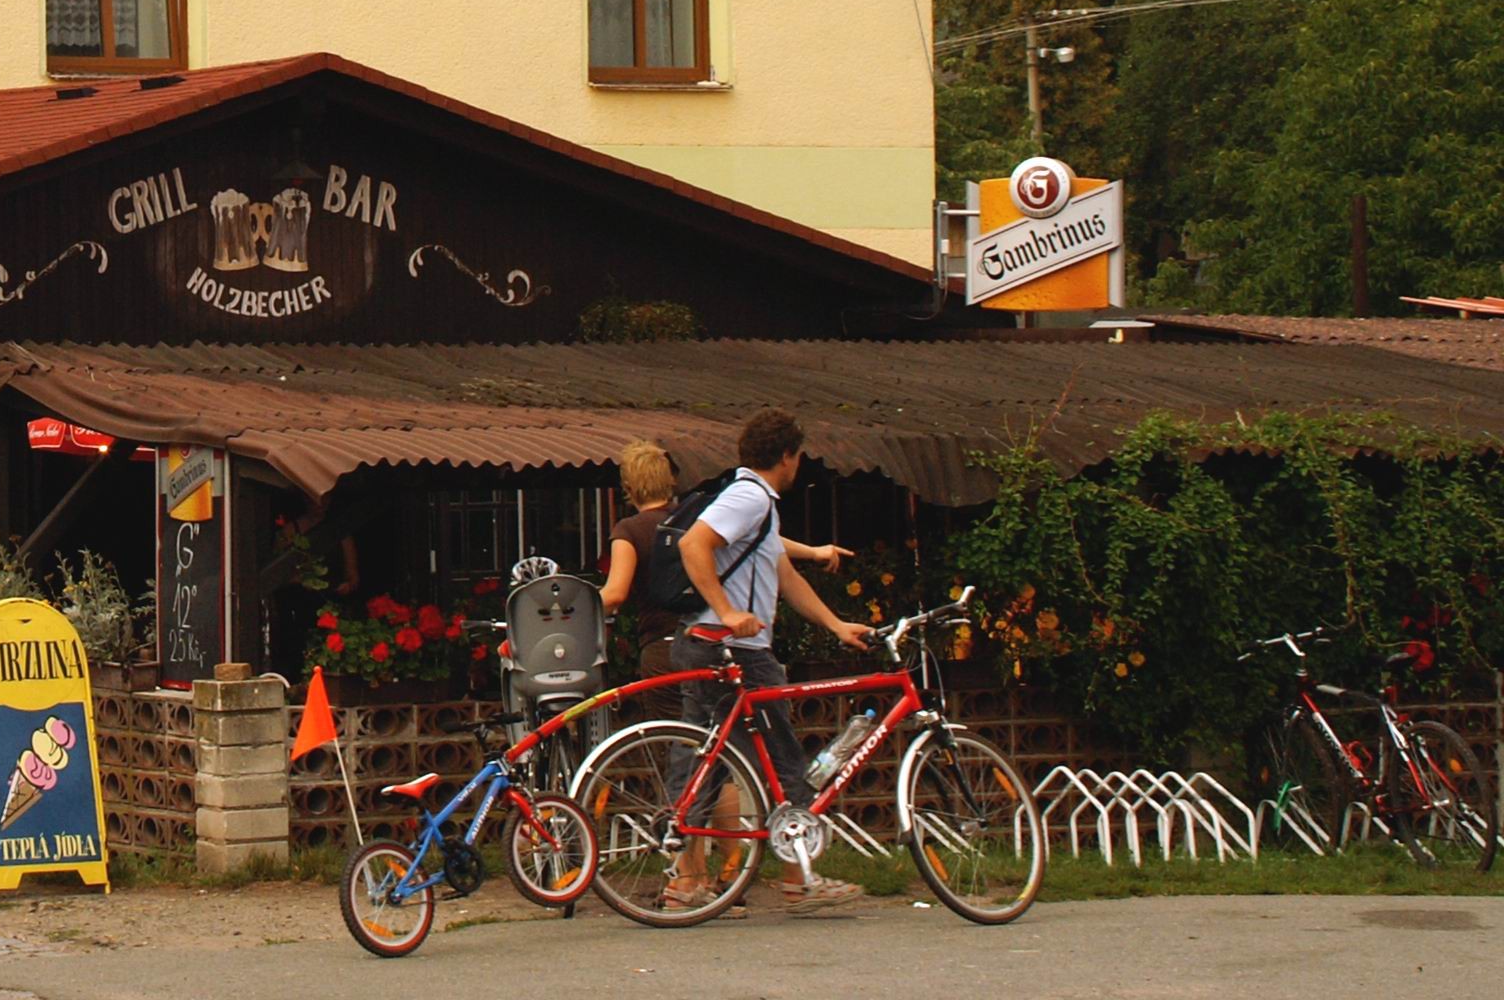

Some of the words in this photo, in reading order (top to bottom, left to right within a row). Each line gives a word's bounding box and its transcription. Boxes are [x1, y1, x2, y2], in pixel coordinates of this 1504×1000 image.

[108, 167, 198, 234] GRILL
[323, 164, 396, 232] BAR
[977, 213, 1107, 280] Gambrinus
[186, 266, 332, 318] HOLZBECHER
[834, 723, 888, 790] AUTHOR
[0, 831, 51, 861] TEPLÁ
[53, 830, 97, 861] JÍDLA
